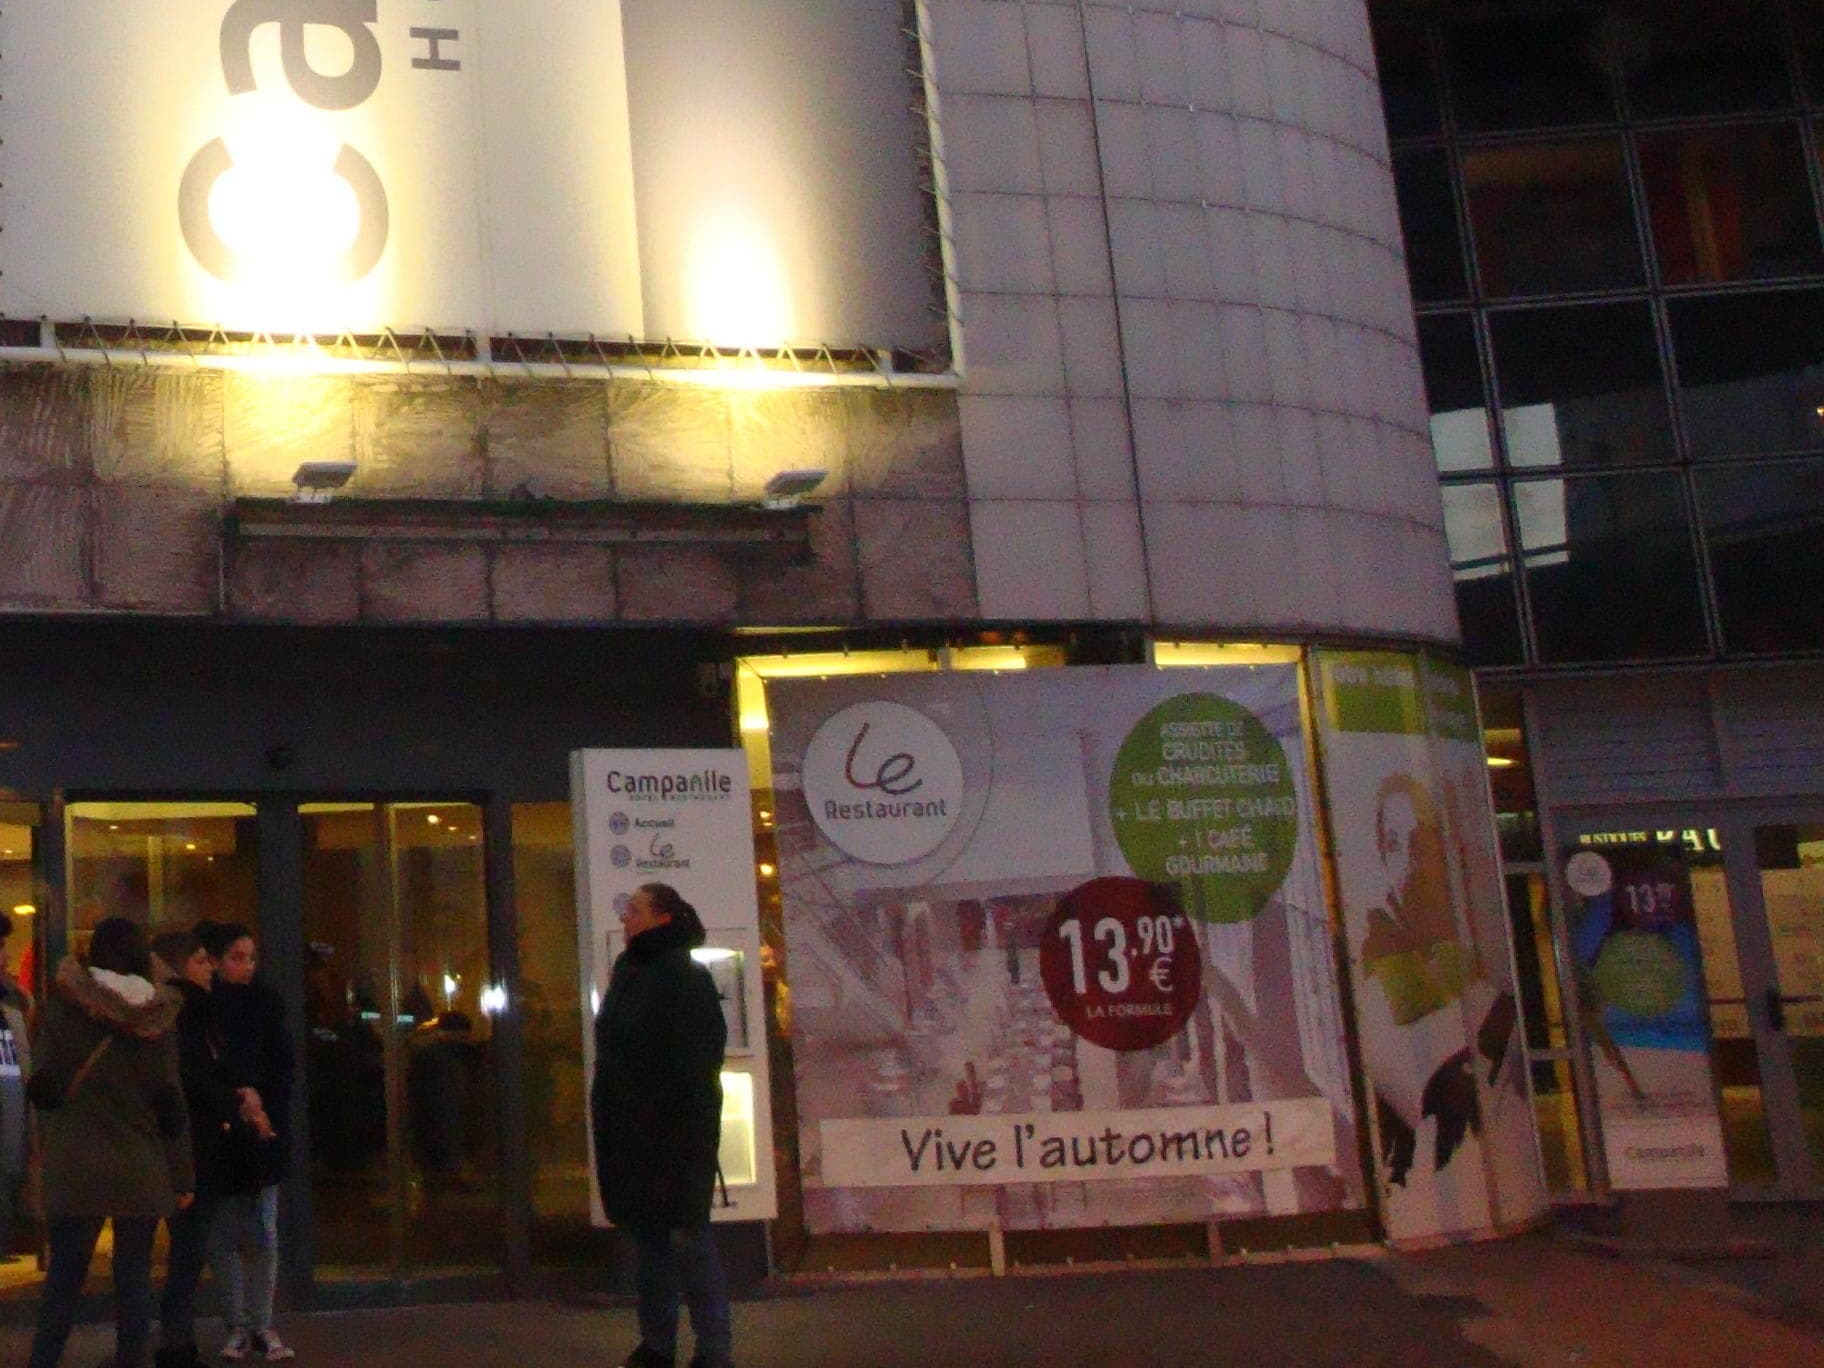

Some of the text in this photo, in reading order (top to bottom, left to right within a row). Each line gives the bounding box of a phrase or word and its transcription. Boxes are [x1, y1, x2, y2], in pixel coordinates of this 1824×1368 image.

[845, 721, 924, 795] Le
[606, 768, 732, 799] Campanile
[1159, 763, 1280, 786] CHARCUTERIE
[824, 799, 948, 820] Restaurant
[1167, 799, 1232, 820] BUFFET
[1086, 1003, 1174, 1018] LA FORMULE
[901, 1128, 998, 1171] Vive
[1014, 1122, 1252, 1170] l'automne
